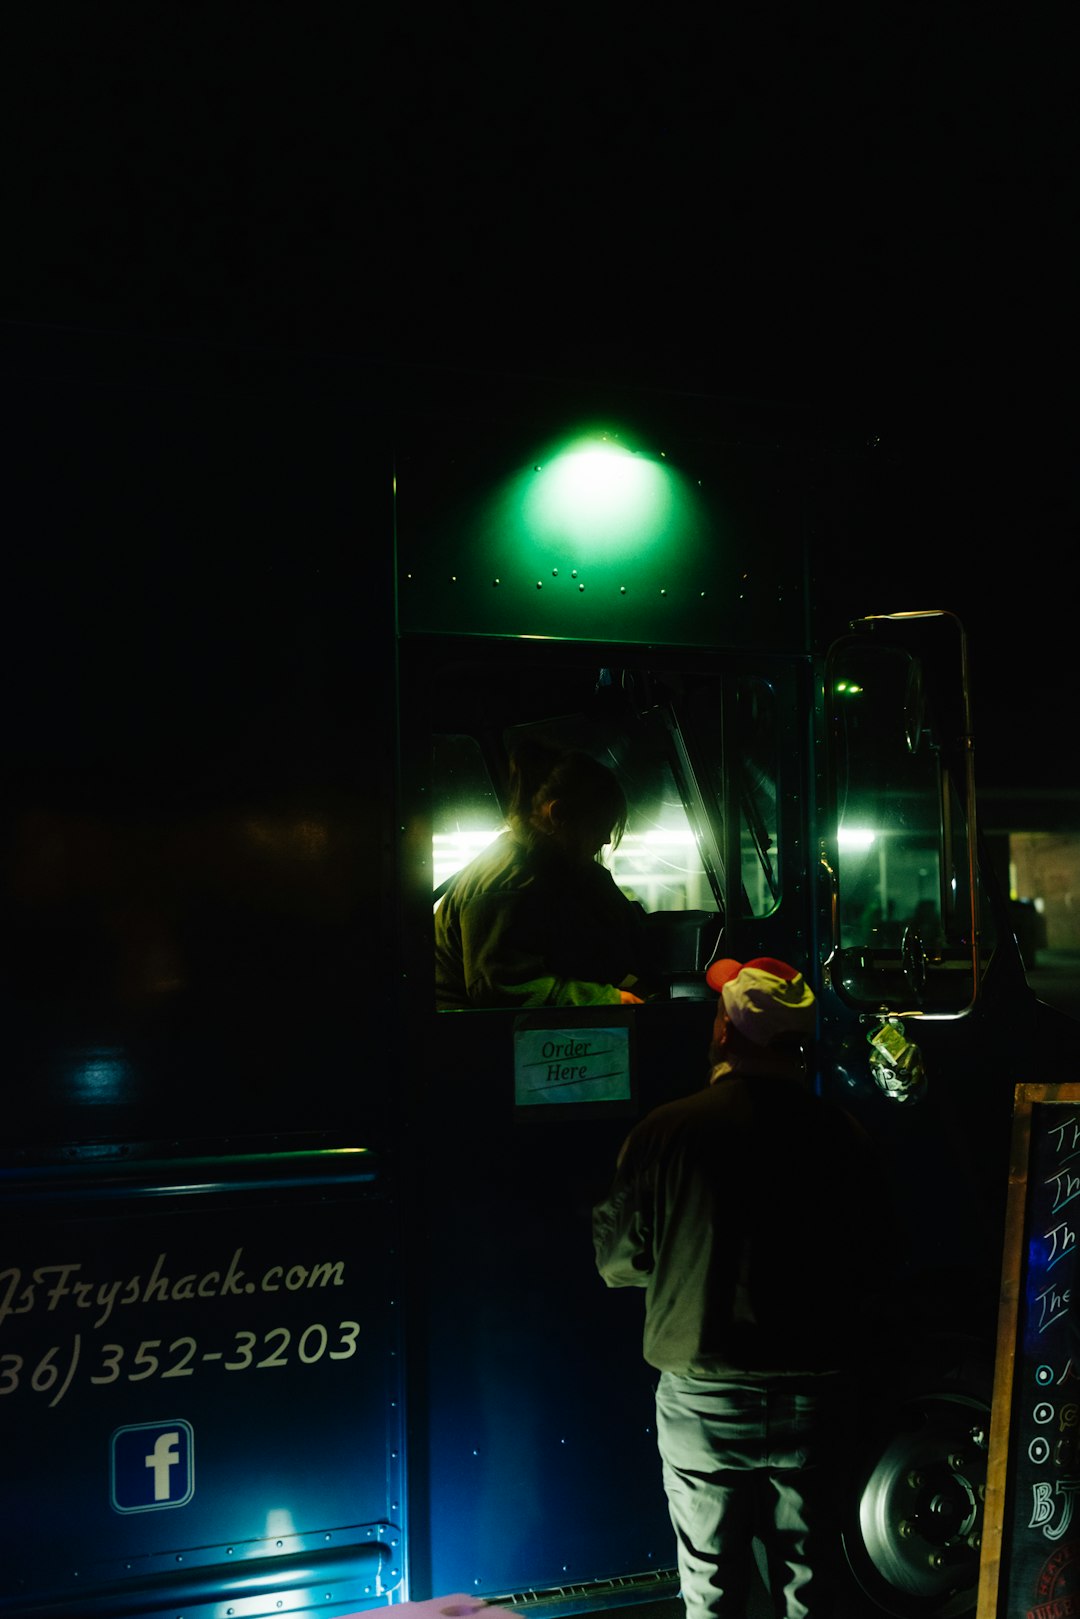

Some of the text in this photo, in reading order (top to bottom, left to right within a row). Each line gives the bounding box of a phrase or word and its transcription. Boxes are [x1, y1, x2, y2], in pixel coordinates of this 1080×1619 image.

[541, 1040, 592, 1059] Order
[545, 1064, 588, 1081] Here
[90, 1321, 361, 1385] 352-3203
[144, 1431, 180, 1501] f
